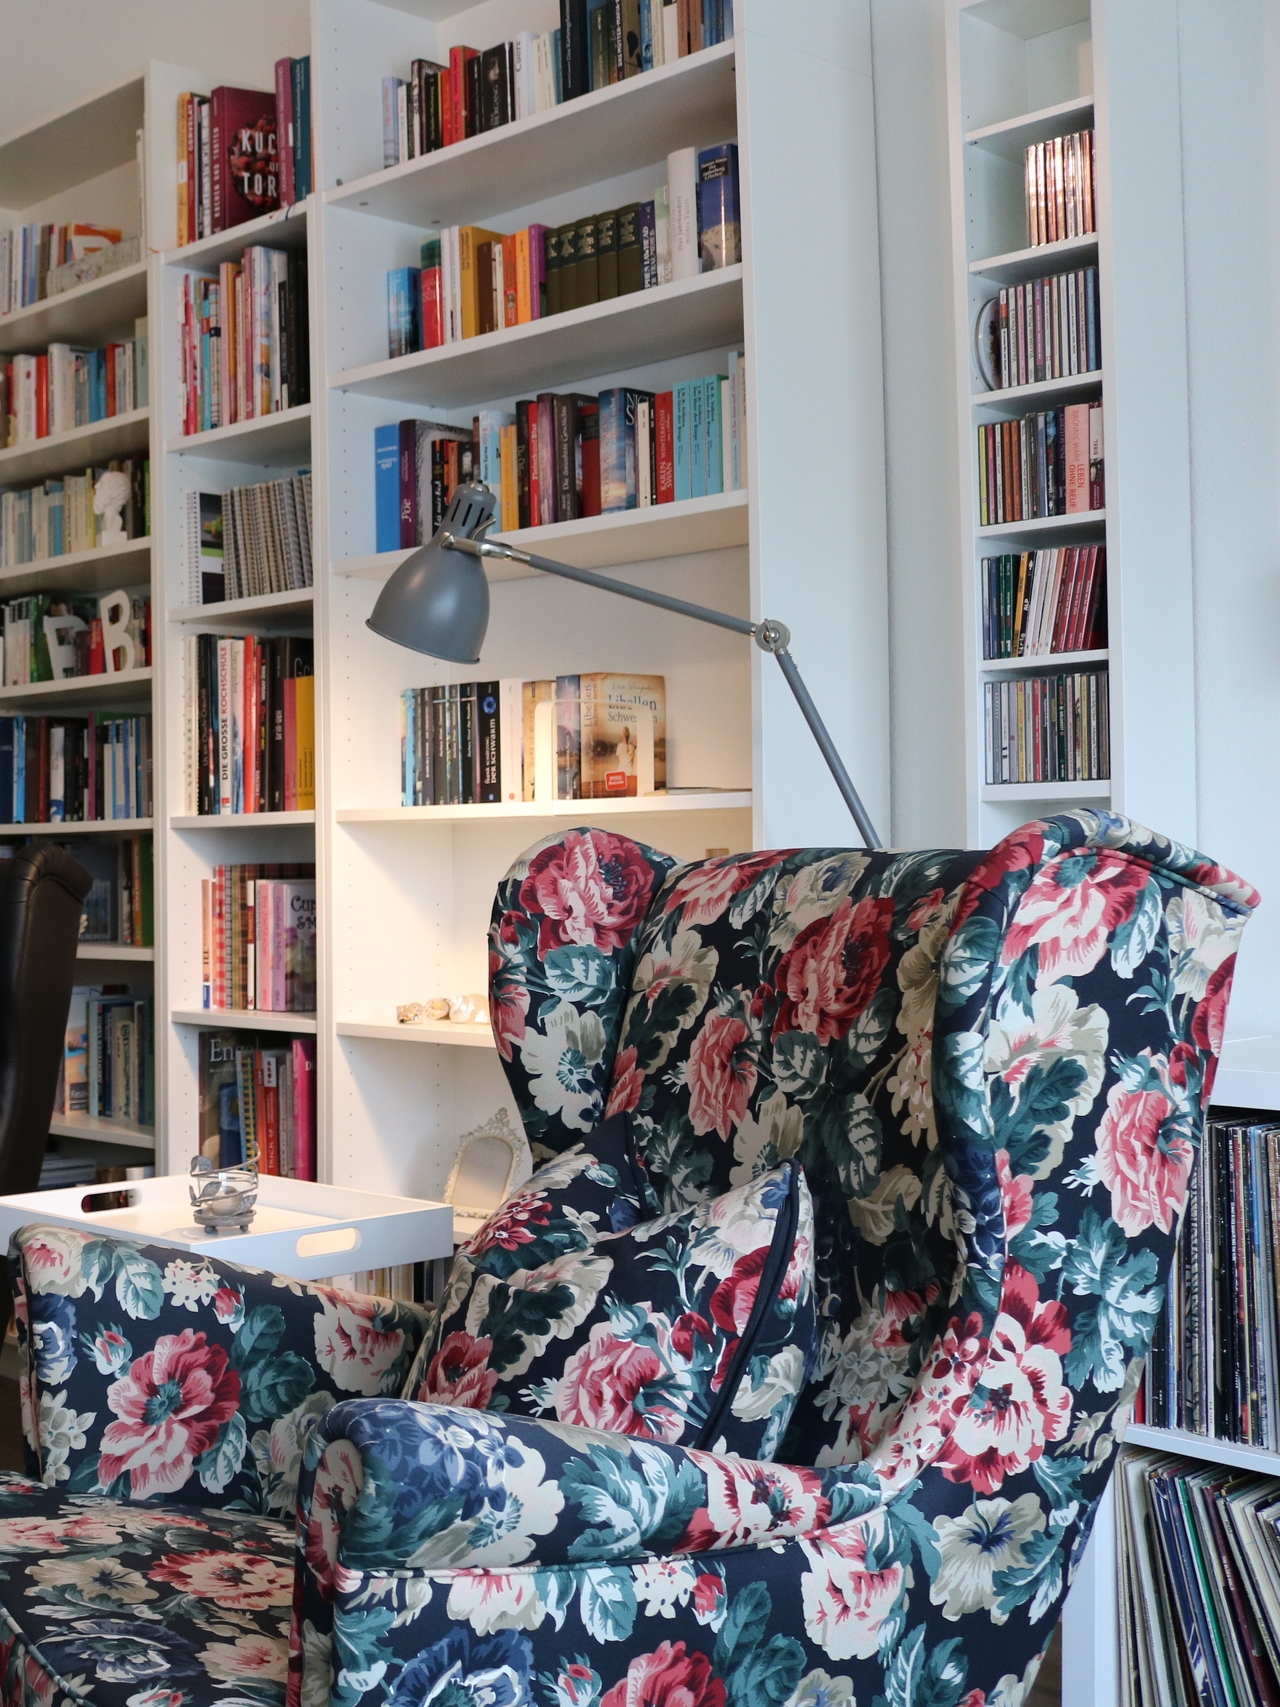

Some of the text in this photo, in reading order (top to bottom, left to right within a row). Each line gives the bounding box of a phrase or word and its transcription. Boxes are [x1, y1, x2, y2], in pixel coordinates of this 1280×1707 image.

[241, 131, 276, 155] KUC
[243, 172, 277, 198] TOR
[1072, 410, 1080, 441] BRONNIE
[1076, 464, 1085, 488] LEBEN
[401, 498, 412, 522] Poe
[1069, 488, 1077, 509] REUE
